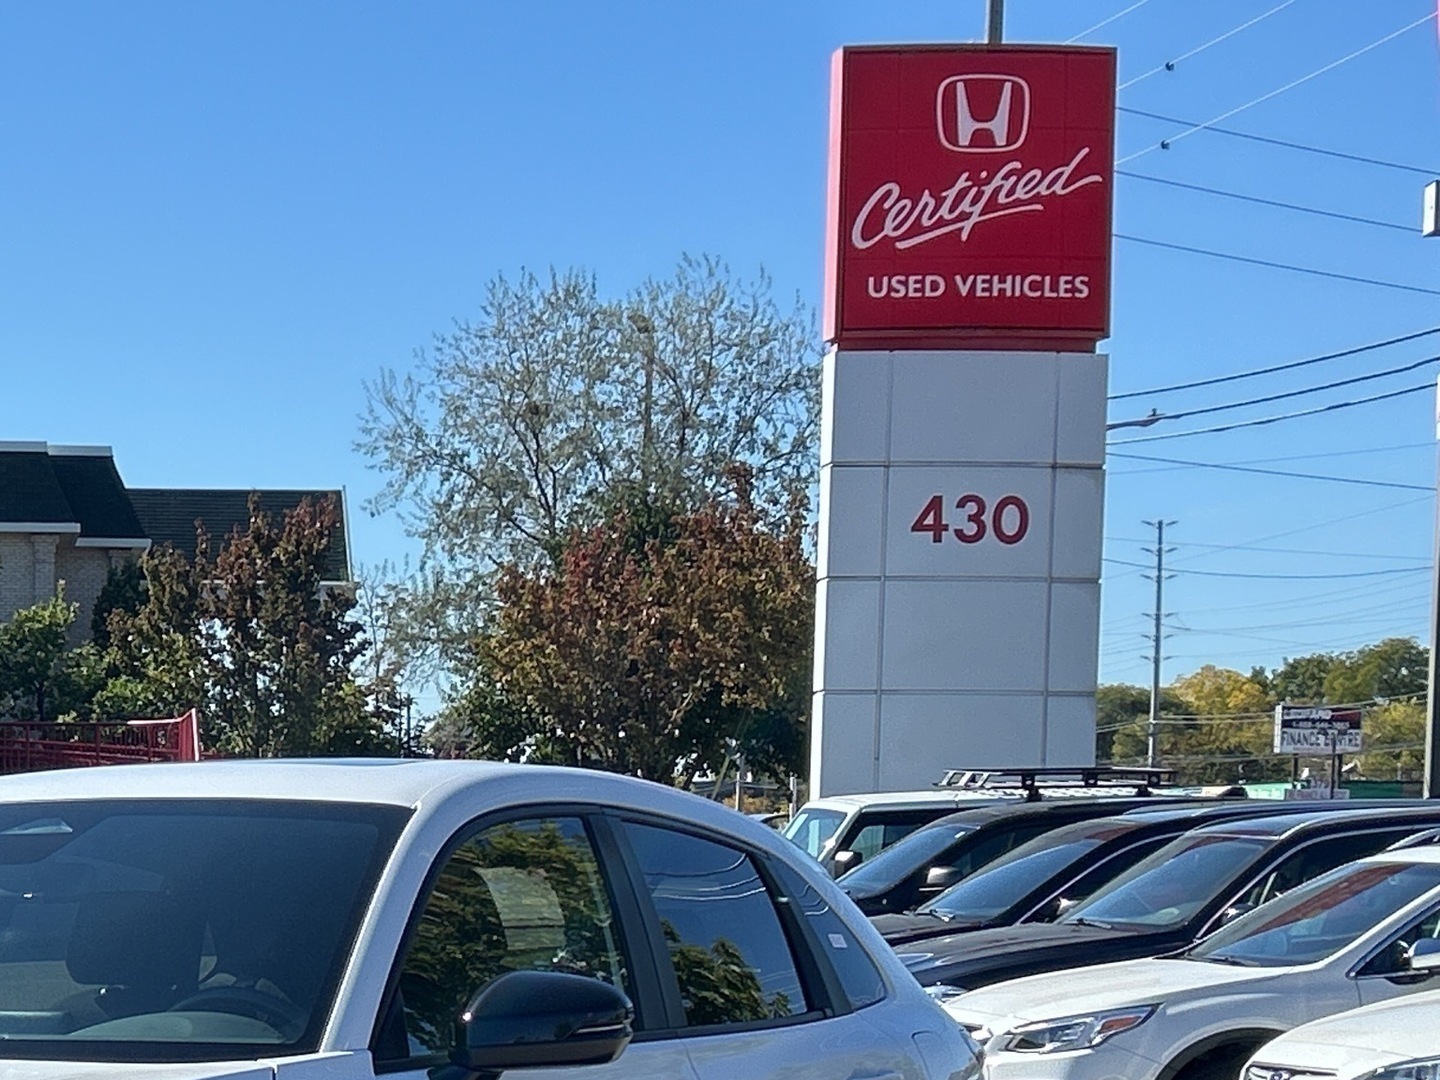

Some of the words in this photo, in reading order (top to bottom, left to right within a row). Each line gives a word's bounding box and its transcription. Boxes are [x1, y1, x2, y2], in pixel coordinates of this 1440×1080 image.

[851, 147, 1103, 249] Certified
[867, 275, 946, 298] USED
[955, 275, 1090, 298] VEHICLES
[910, 494, 1030, 545] 430
